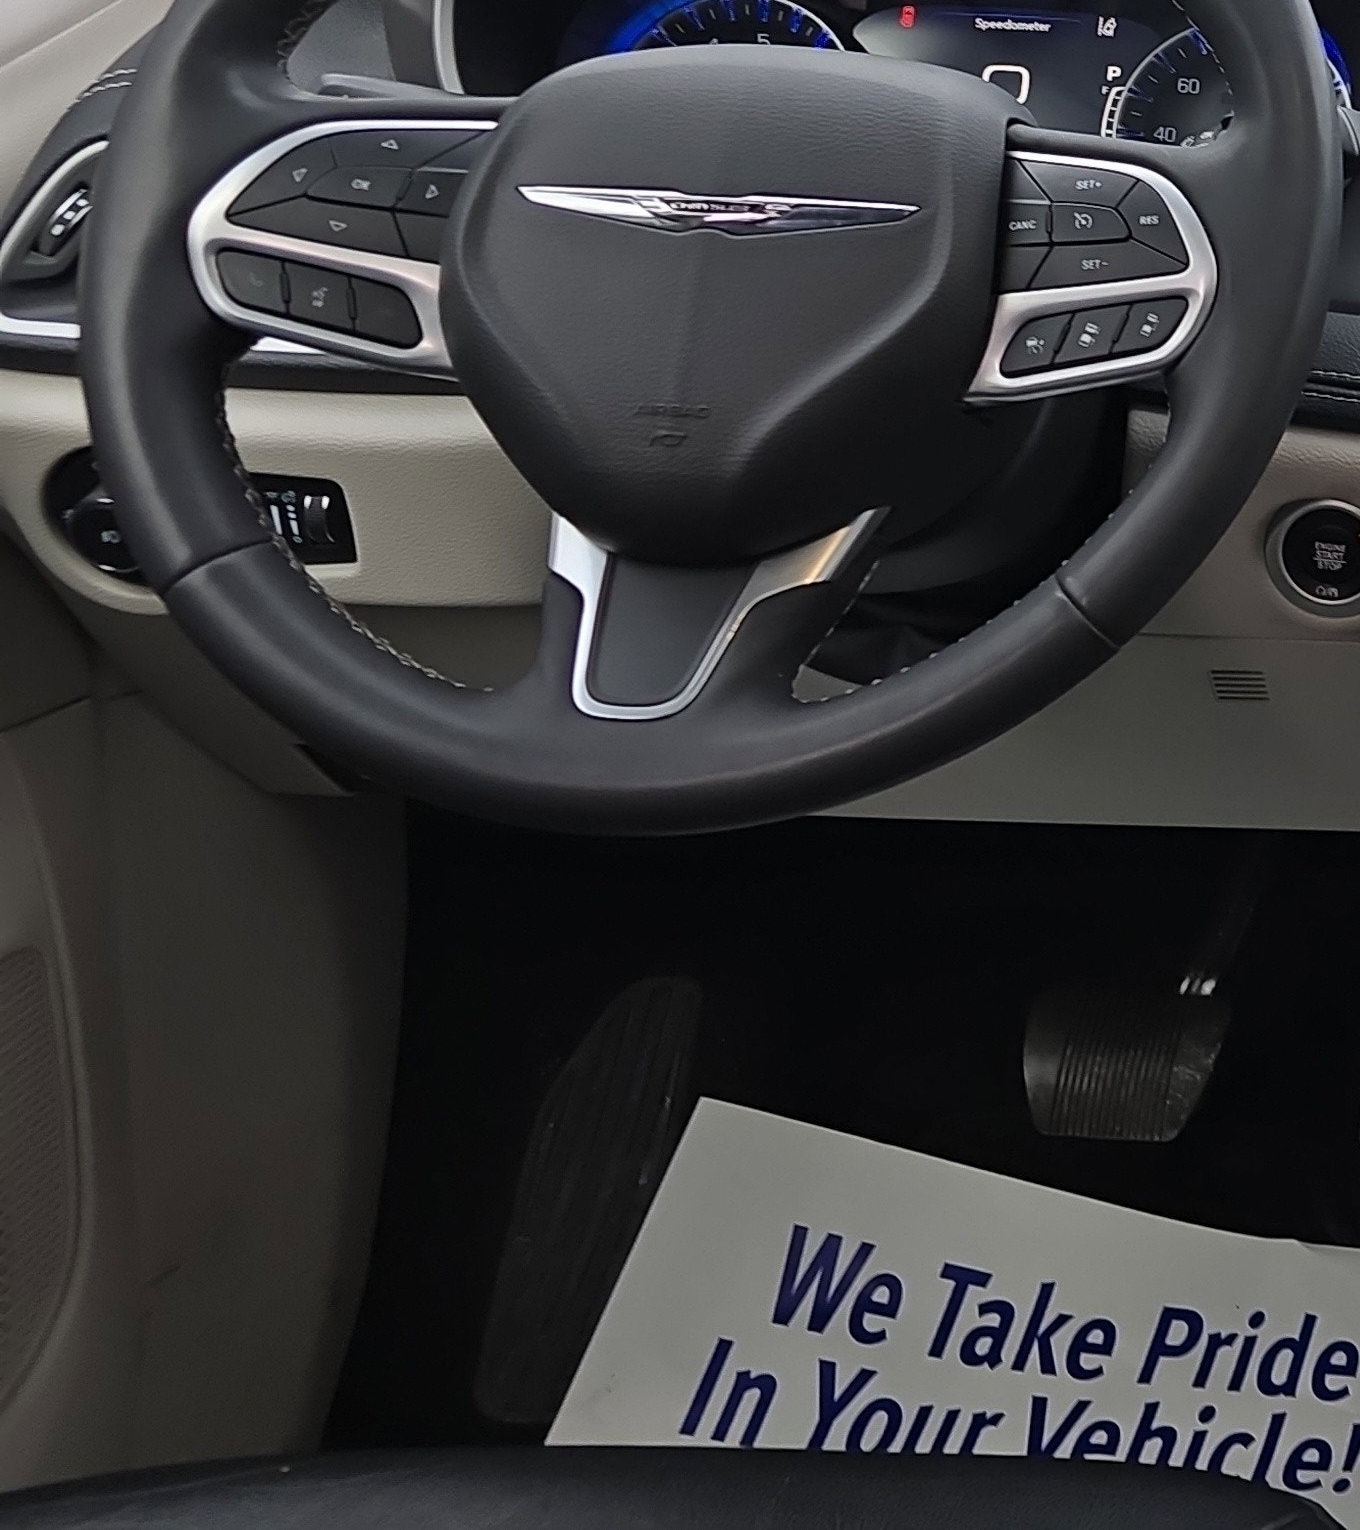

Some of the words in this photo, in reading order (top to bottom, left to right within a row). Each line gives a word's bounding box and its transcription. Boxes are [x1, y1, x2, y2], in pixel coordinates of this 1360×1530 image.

[975, 17, 1051, 32] Speedometer
[1106, 66, 1121, 81] P
[1177, 78, 1200, 95] 60
[1153, 126, 1177, 143] 40
[1008, 220, 1037, 231] CANC
[1139, 215, 1160, 225] RES
[769, 1222, 905, 1346] We
[926, 1261, 1119, 1381] Take
[677, 1336, 780, 1448] In
[806, 1358, 1006, 1457] Your
